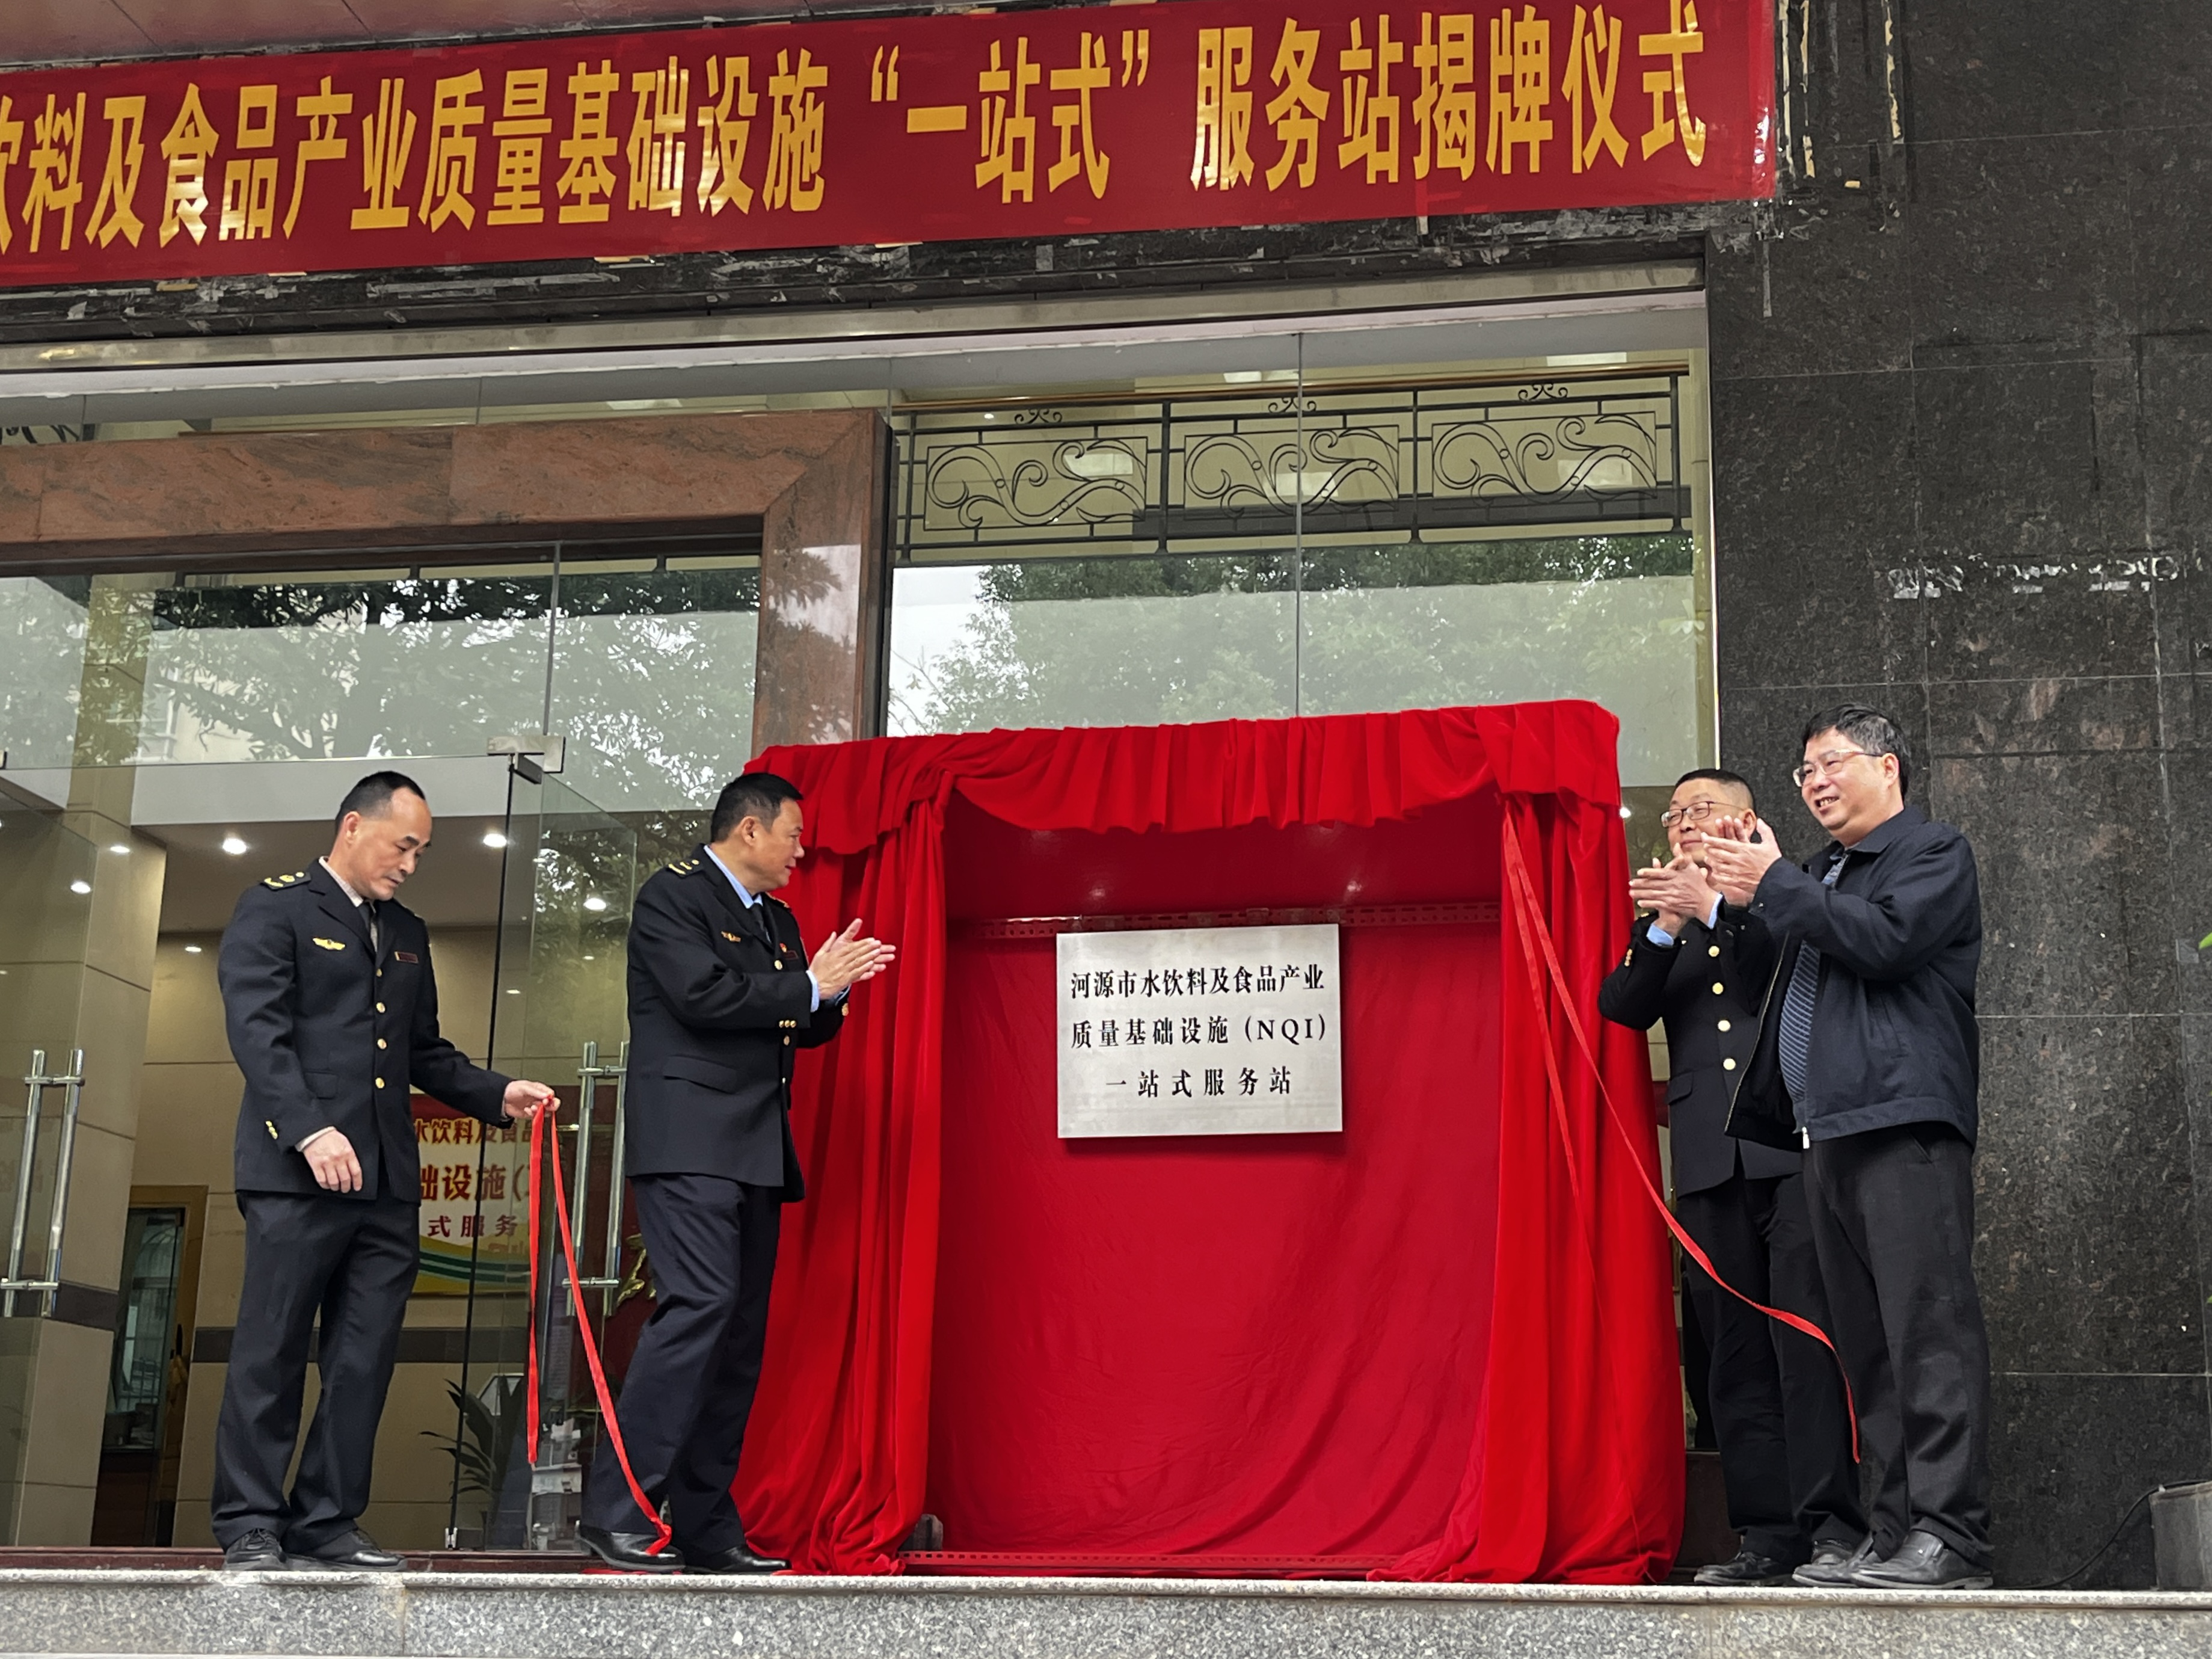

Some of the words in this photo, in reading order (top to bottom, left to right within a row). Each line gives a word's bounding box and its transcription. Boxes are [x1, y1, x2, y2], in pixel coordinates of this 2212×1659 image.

[1071, 964, 1324, 999] 河源市水饮料及食品产业
[1105, 1066, 1291, 1098] 一站式服务站
